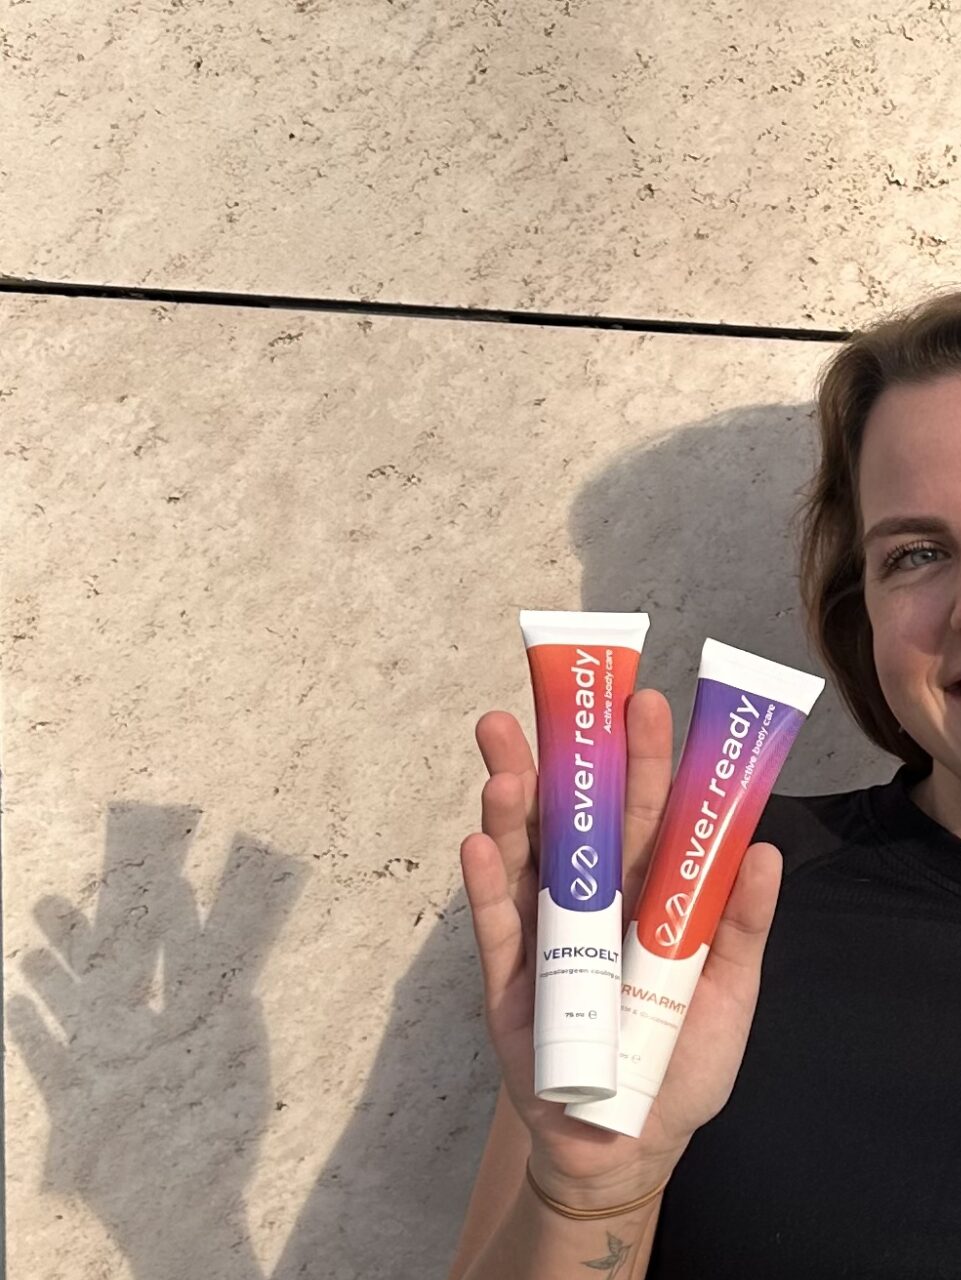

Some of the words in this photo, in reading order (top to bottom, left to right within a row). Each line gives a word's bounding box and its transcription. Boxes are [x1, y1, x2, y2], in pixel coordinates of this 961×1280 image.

[605, 649, 613, 671] care
[570, 648, 601, 746] ready
[604, 672, 614, 699] body
[603, 700, 613, 734] Active
[740, 755, 758, 790] Active
[751, 726, 769, 756] body
[762, 703, 776, 727] care
[574, 752, 594, 832] ever
[680, 800, 719, 880] ever
[708, 694, 760, 798] ready
[543, 946, 619, 963] VERKOELT
[621, 984, 686, 1015] RWARMT
